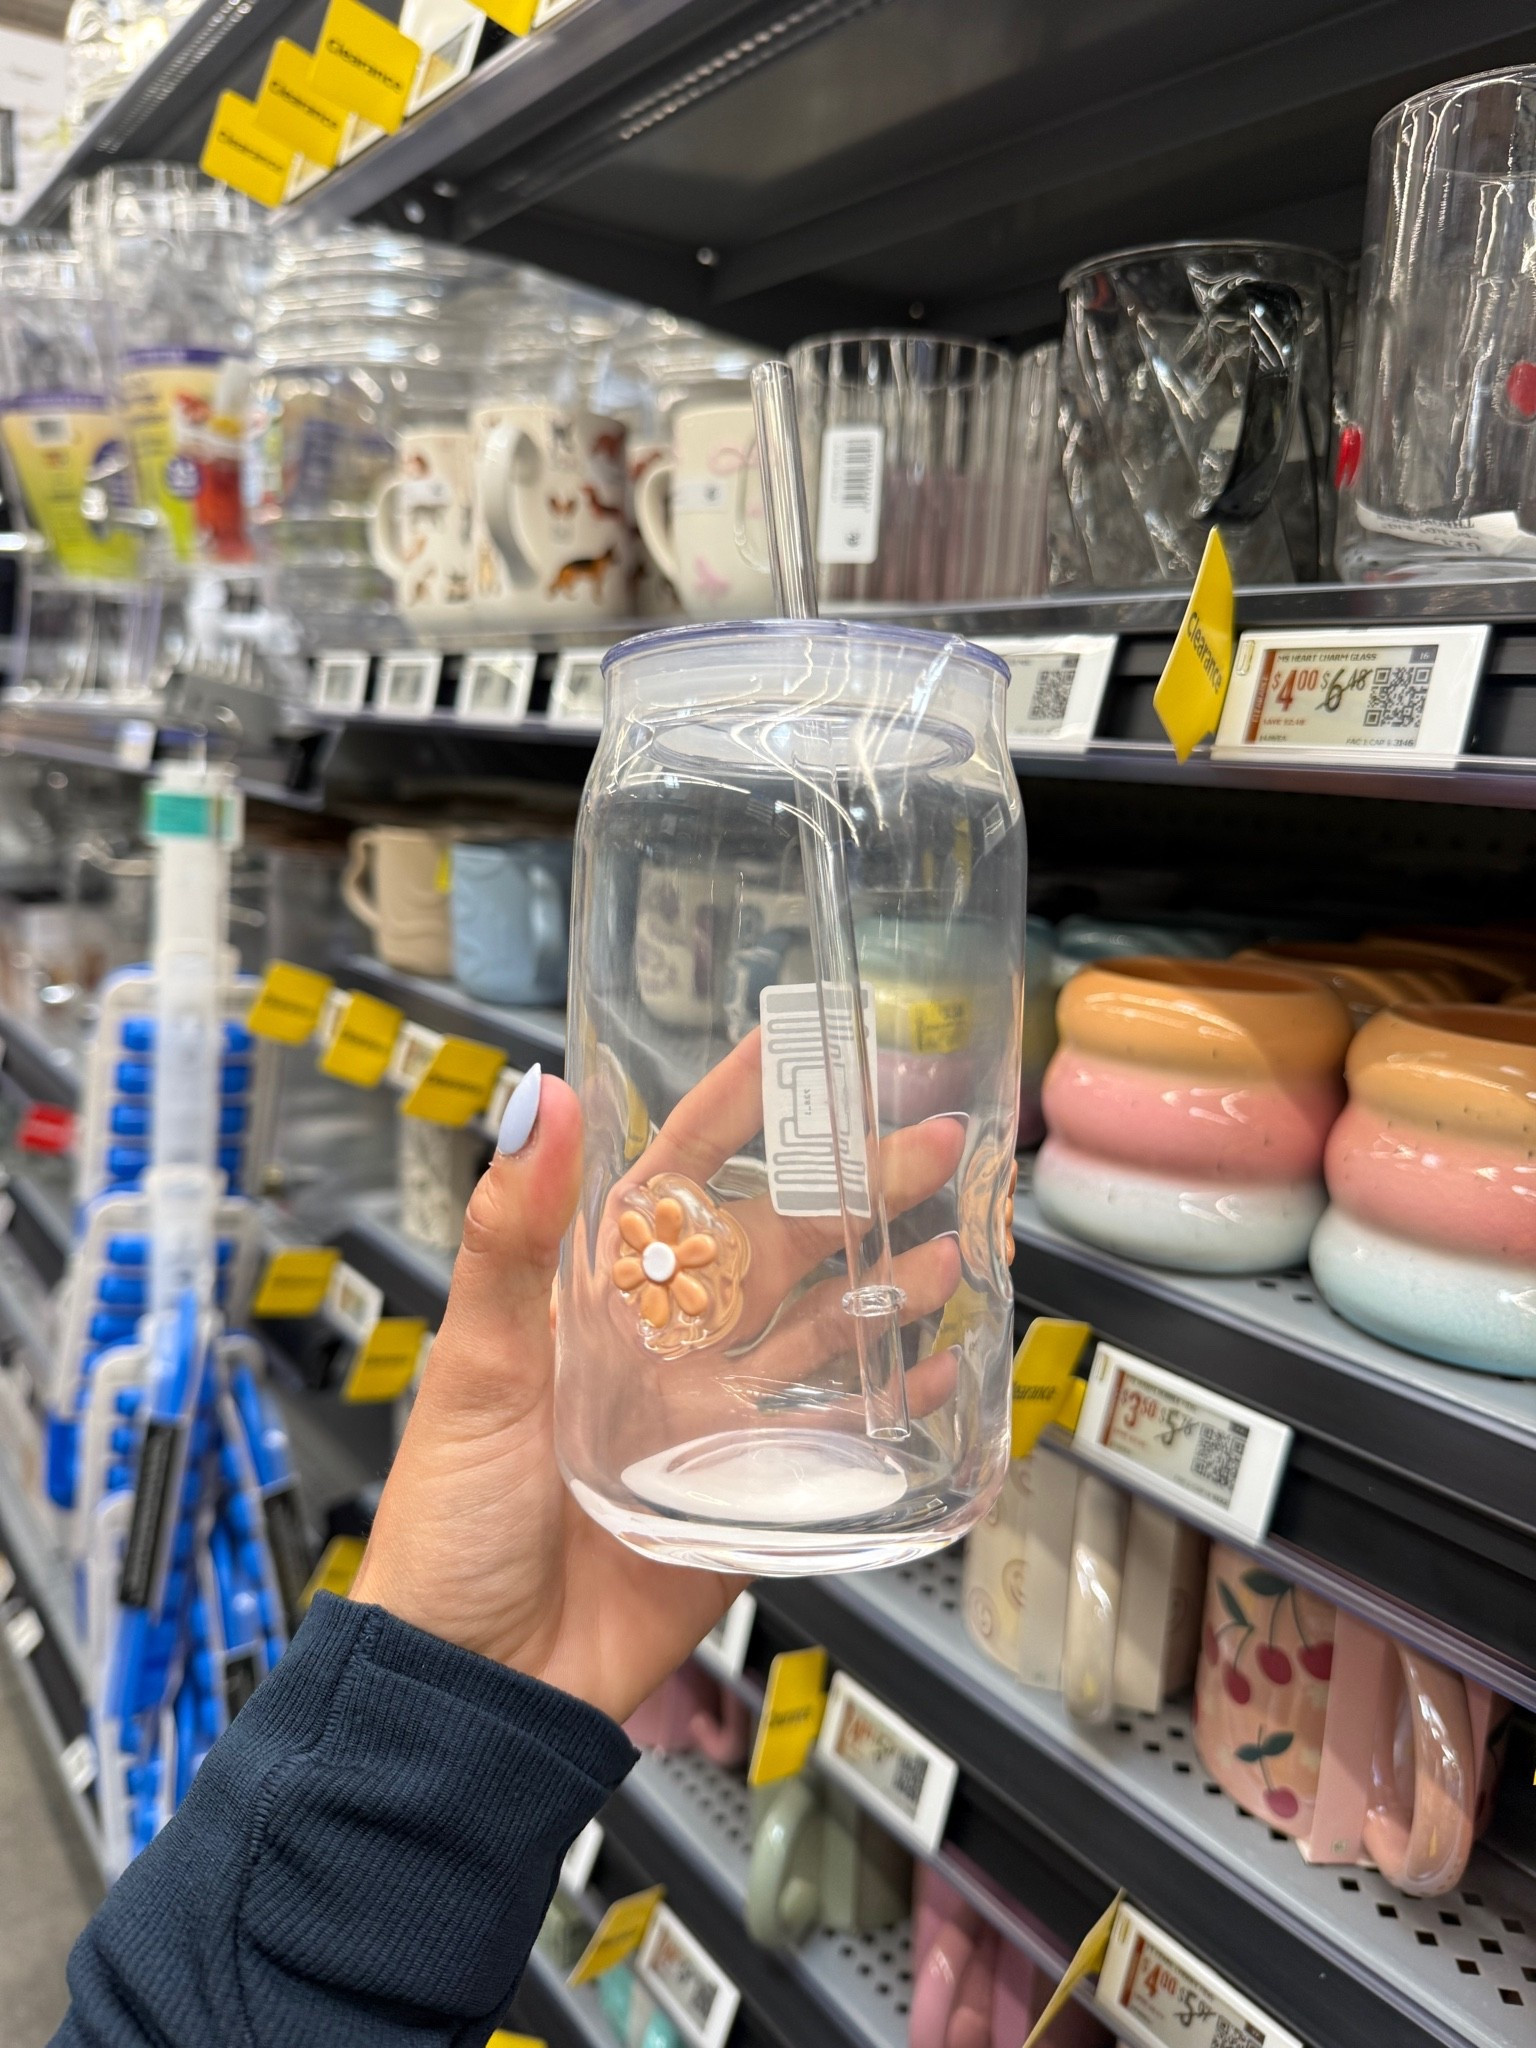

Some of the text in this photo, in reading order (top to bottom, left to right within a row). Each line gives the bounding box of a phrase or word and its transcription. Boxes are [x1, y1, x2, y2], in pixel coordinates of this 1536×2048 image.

[326, 37, 403, 91] Clearance
[1186, 611, 1224, 695] Clearance
[1291, 654, 1317, 662] HEART
[1319, 654, 1349, 662] CHARM
[1350, 653, 1377, 661] GLASS
[1012, 1380, 1056, 1401] learance
